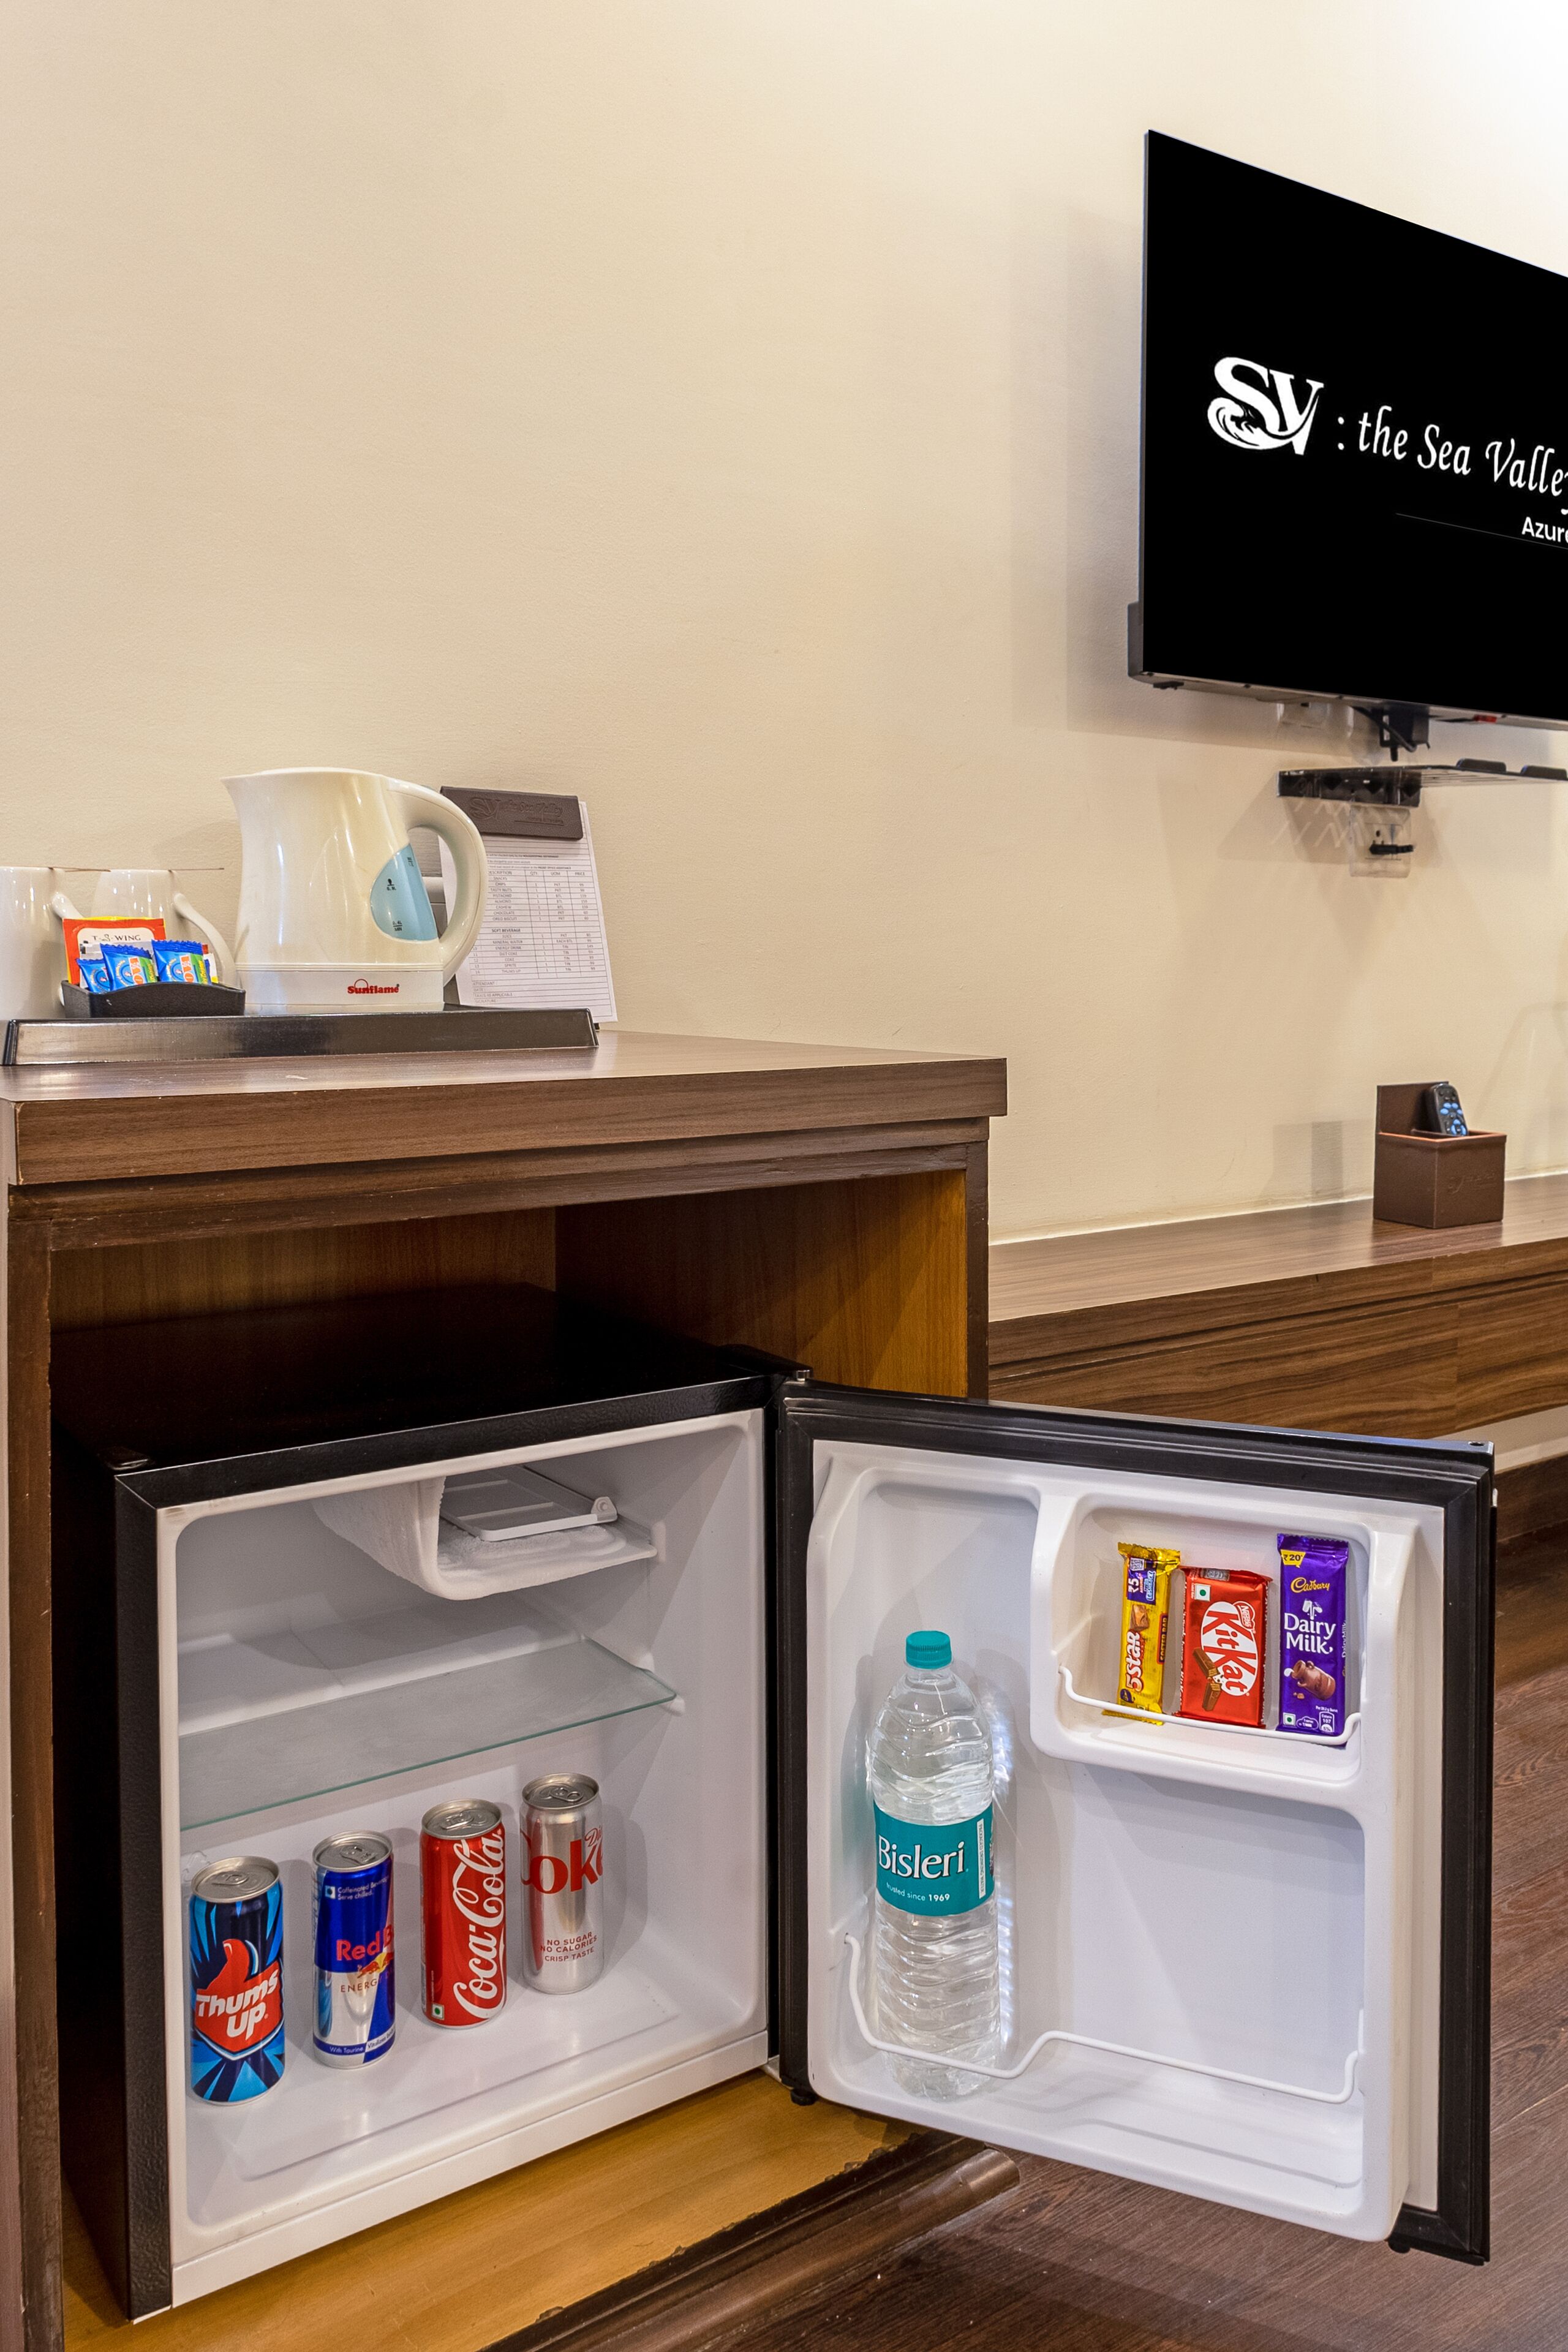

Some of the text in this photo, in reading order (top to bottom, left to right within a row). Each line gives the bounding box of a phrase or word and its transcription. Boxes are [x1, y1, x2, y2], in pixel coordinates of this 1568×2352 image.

[1359, 405, 1408, 460] the
[1417, 424, 1471, 476] Sea
[347, 985, 399, 994] Sunflame
[1291, 1577, 1330, 1593] Cadbury
[1284, 1612, 1336, 1640] Dairy
[1202, 1610, 1257, 1692] KitKat
[1286, 1632, 1330, 1654] Milk
[878, 1834, 966, 1879] Bisleri
[886, 1882, 951, 1902] trusted since 1969
[336, 1930, 380, 1962] Red
[556, 1935, 598, 1953] CALORIES
[564, 1931, 592, 1946] SUGAR
[571, 1946, 595, 1961] TASTE
[196, 1969, 279, 2018] Thums
